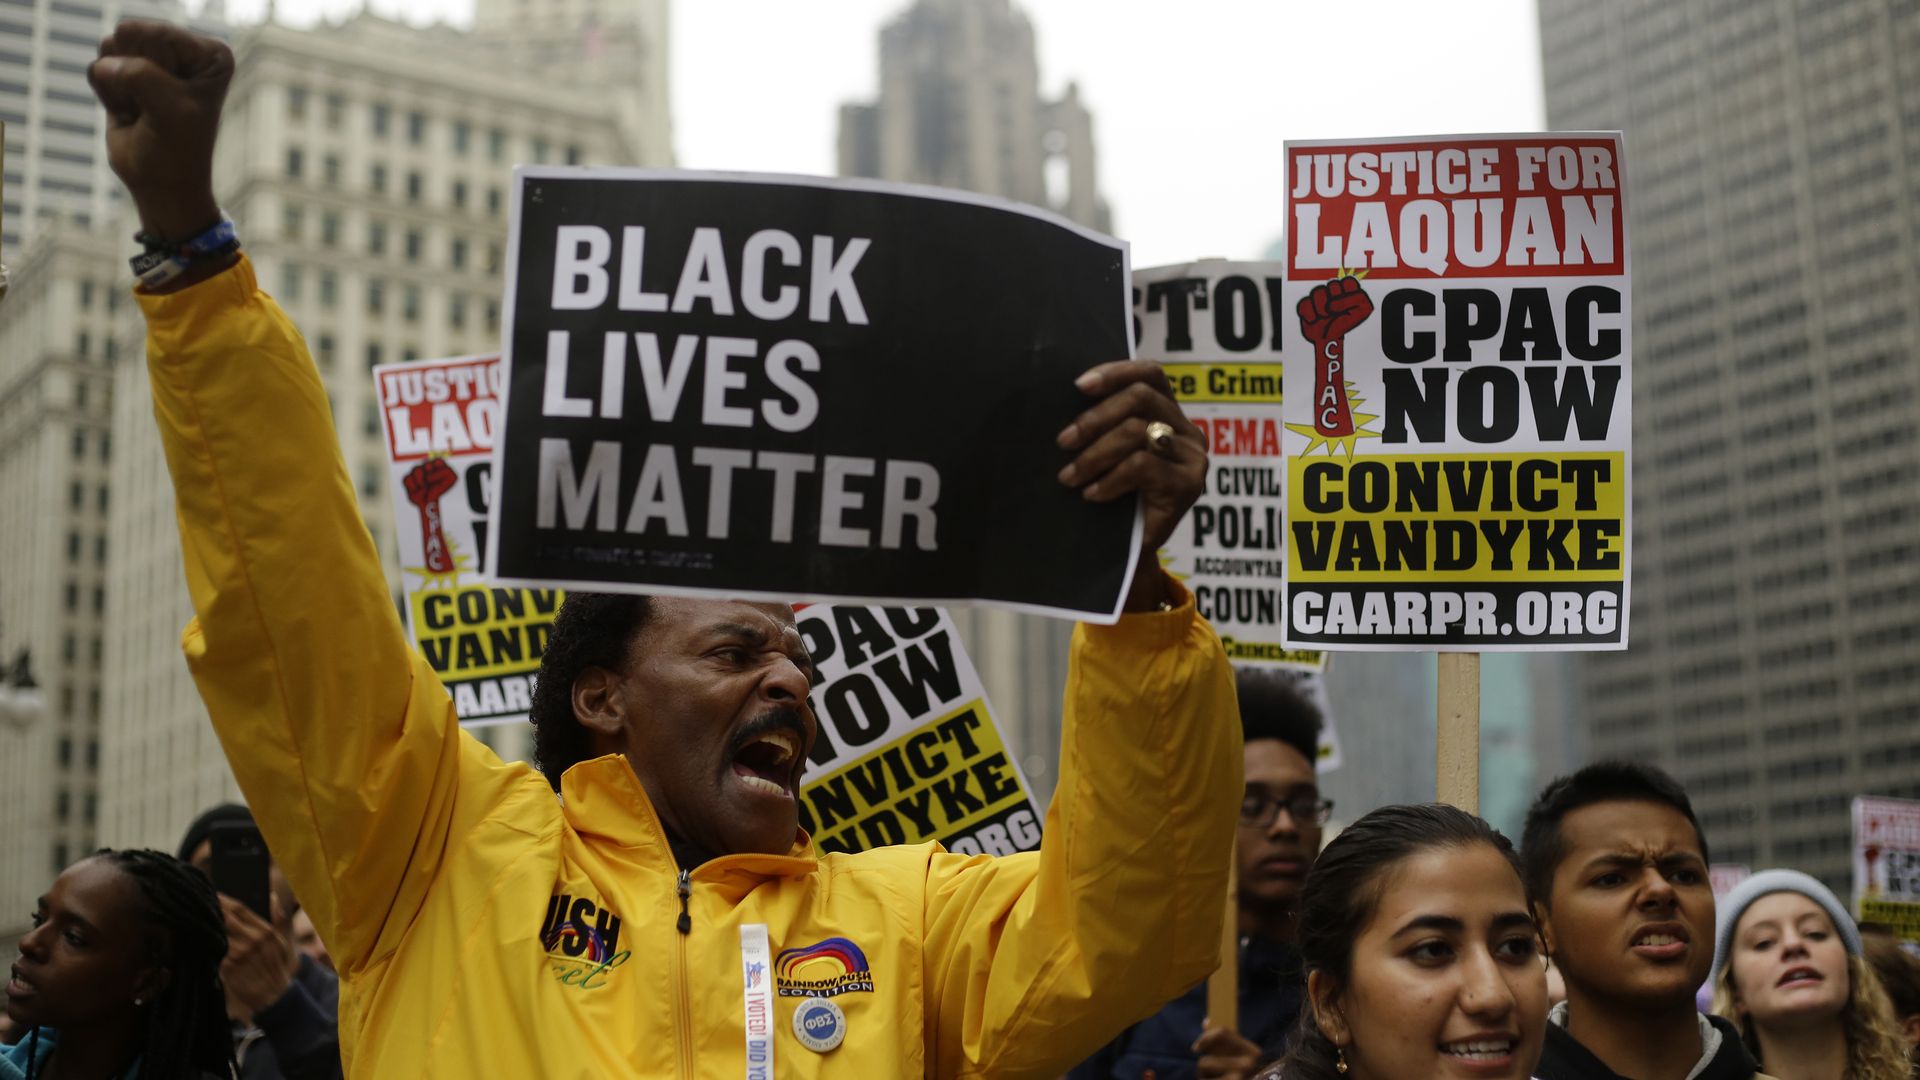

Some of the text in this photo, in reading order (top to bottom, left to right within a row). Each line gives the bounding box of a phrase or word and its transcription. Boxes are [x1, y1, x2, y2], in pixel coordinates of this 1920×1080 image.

[1293, 146, 1616, 199] JUSTICE FOR
[1294, 195, 1616, 277] LAQUAN
[551, 225, 872, 325] BLACK
[1132, 275, 1282, 352] TO
[1381, 285, 1622, 364] CPAC
[542, 330, 821, 433] LIVES
[1208, 368, 1282, 395] Crim
[1320, 340, 1338, 430] CPAC
[1382, 365, 1622, 443] NOW
[537, 437, 941, 551] MATTER
[1303, 459, 1611, 514] CONVICT
[1193, 505, 1282, 550] POLI
[1292, 519, 1621, 572] VANDYKE
[1195, 585, 1282, 625] COUN
[1292, 590, 1619, 636] CAARPR.ORG
[447, 675, 538, 718] AAR
[779, 983, 873, 997] COALITION
[748, 998, 767, 1036] VOTED!
[749, 1041, 767, 1062] DID
